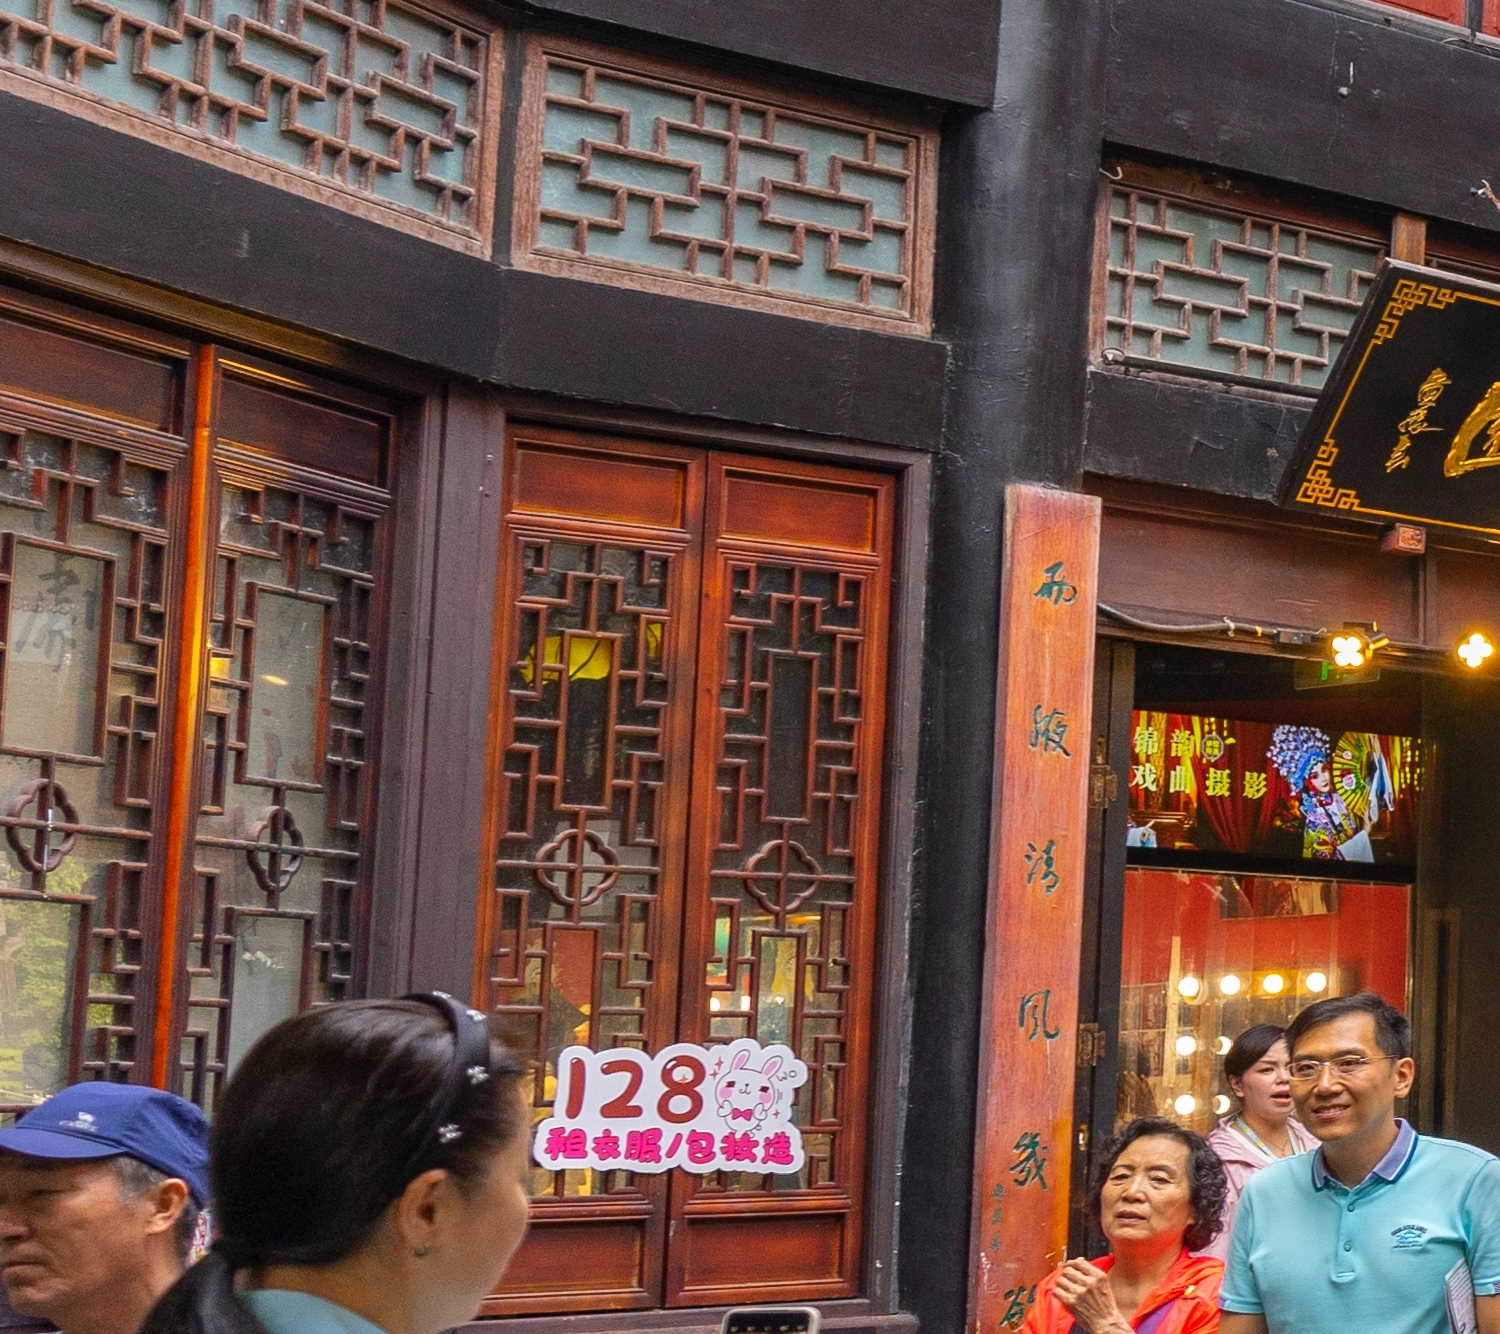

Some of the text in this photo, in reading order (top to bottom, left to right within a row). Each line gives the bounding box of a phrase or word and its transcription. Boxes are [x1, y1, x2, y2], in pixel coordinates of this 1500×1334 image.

[1131, 762, 1268, 800] 戏曲摄影
[566, 1055, 706, 1124] 128
[544, 1127, 794, 1165] 租衣服/包妆造
